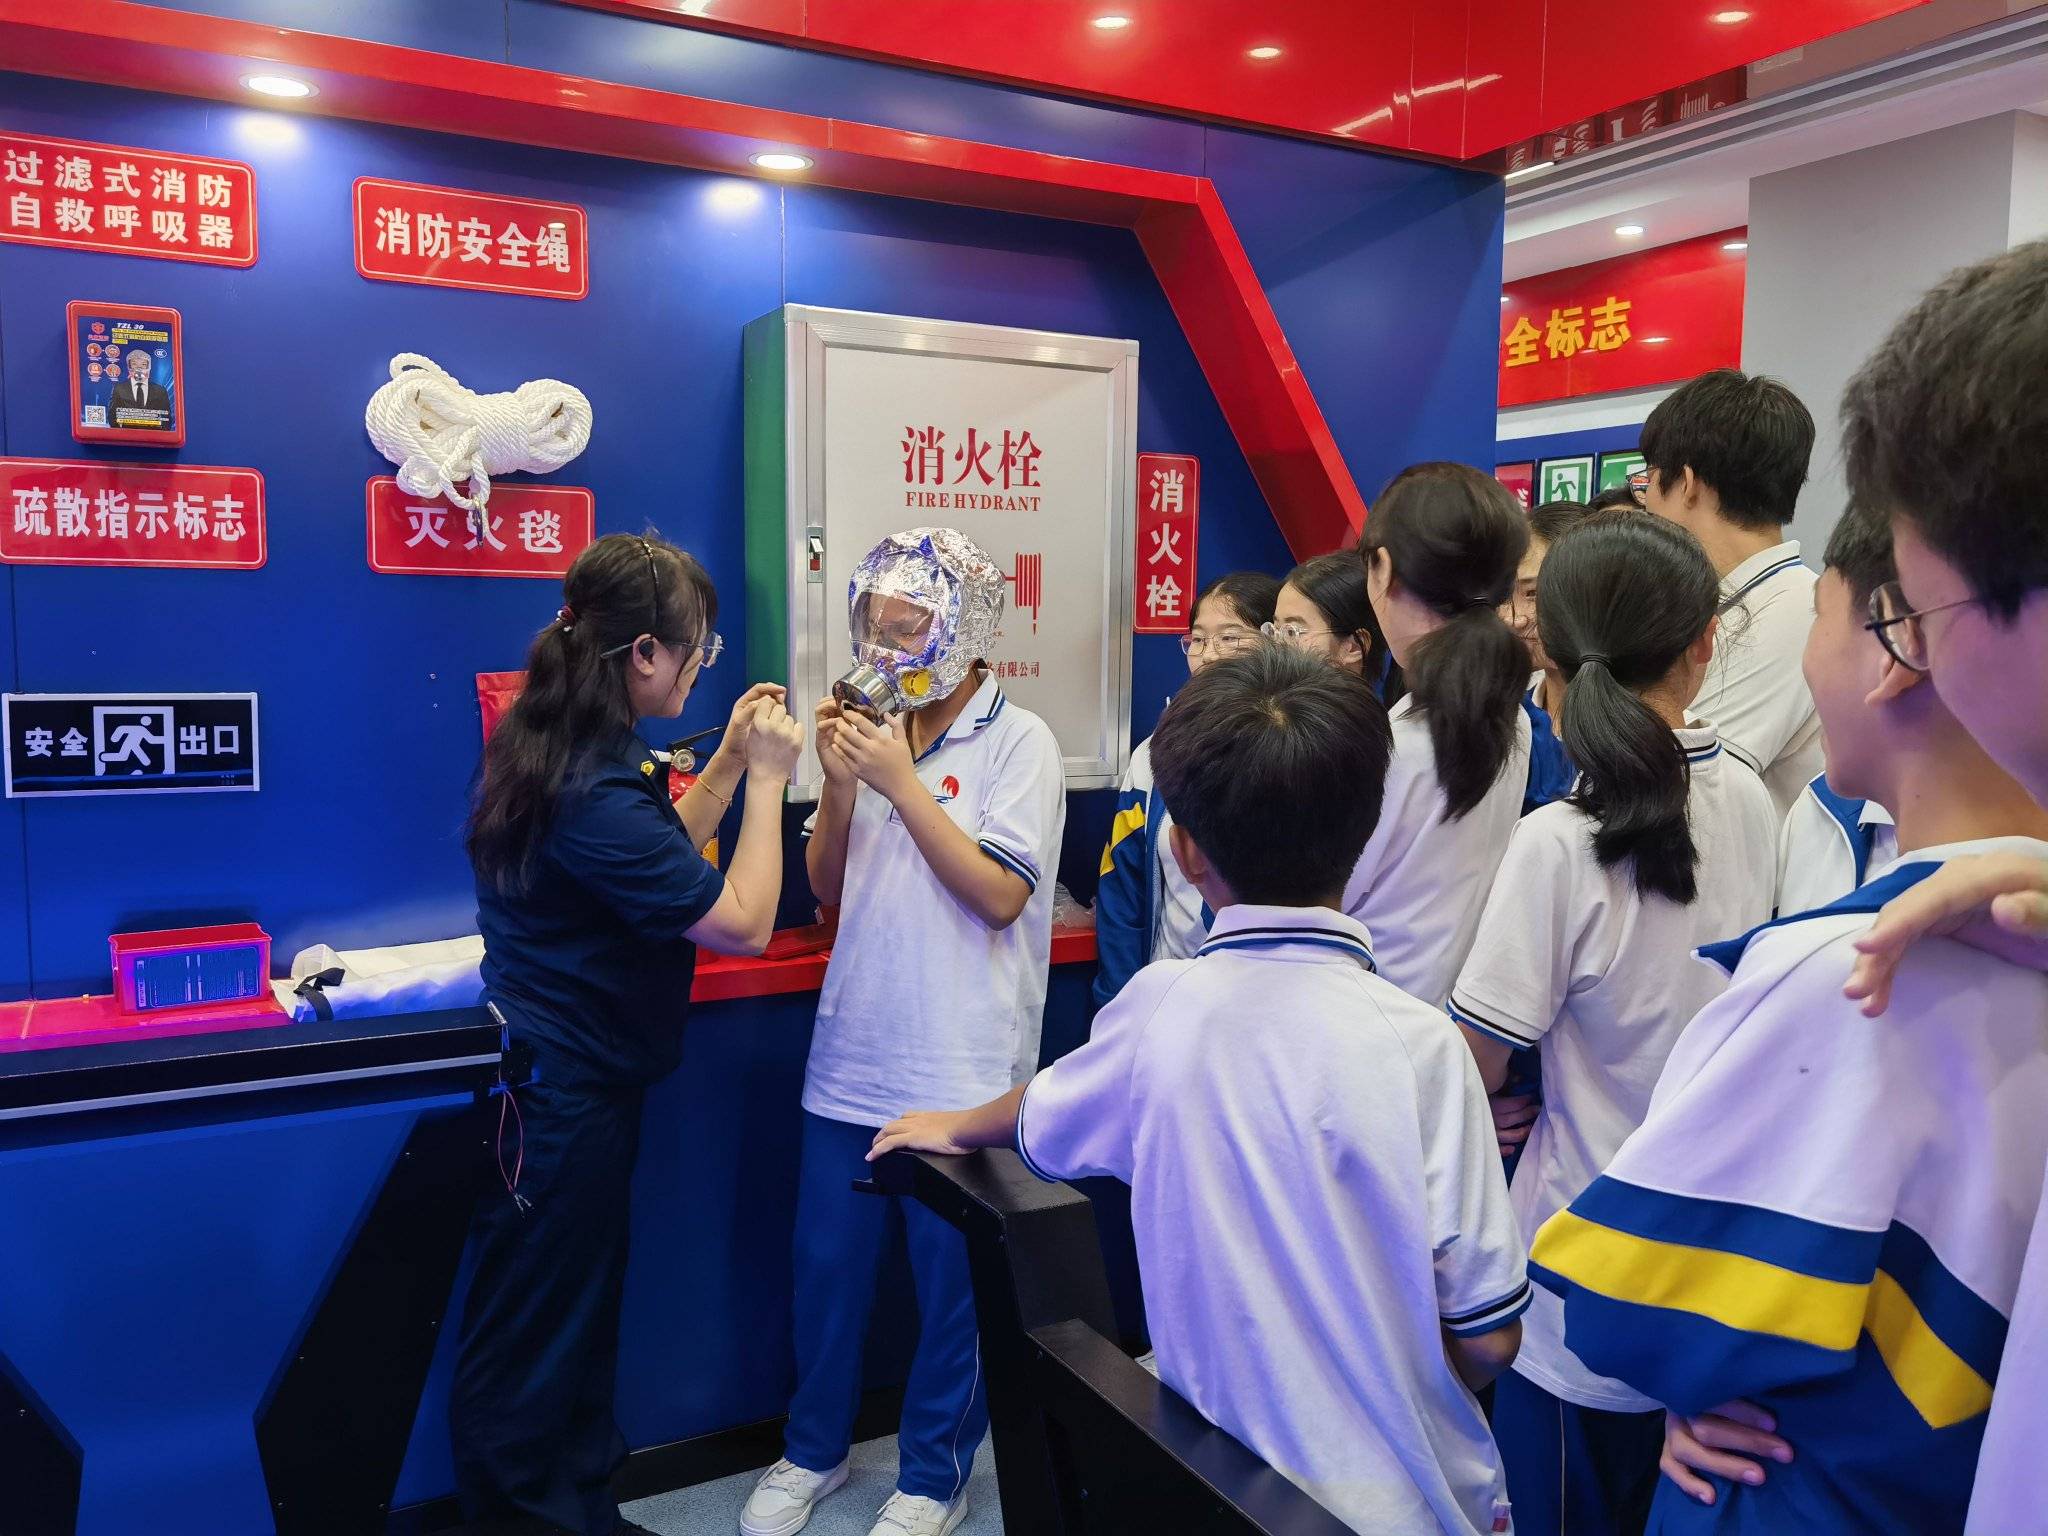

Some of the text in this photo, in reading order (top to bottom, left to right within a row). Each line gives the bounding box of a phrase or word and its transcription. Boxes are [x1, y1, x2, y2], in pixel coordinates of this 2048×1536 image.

[4, 150, 233, 208] 过滤式消防
[10, 192, 234, 249] 自救呼吸器
[374, 207, 571, 273] 消防安全绳
[1504, 296, 1632, 368] 全标志
[901, 426, 1042, 490] 消火栓
[12, 486, 247, 541] 疏散指示标志
[905, 491, 1041, 512] FIRE HYDRANT
[1146, 469, 1185, 618] 消火栓
[25, 725, 239, 757] 安全 出口
